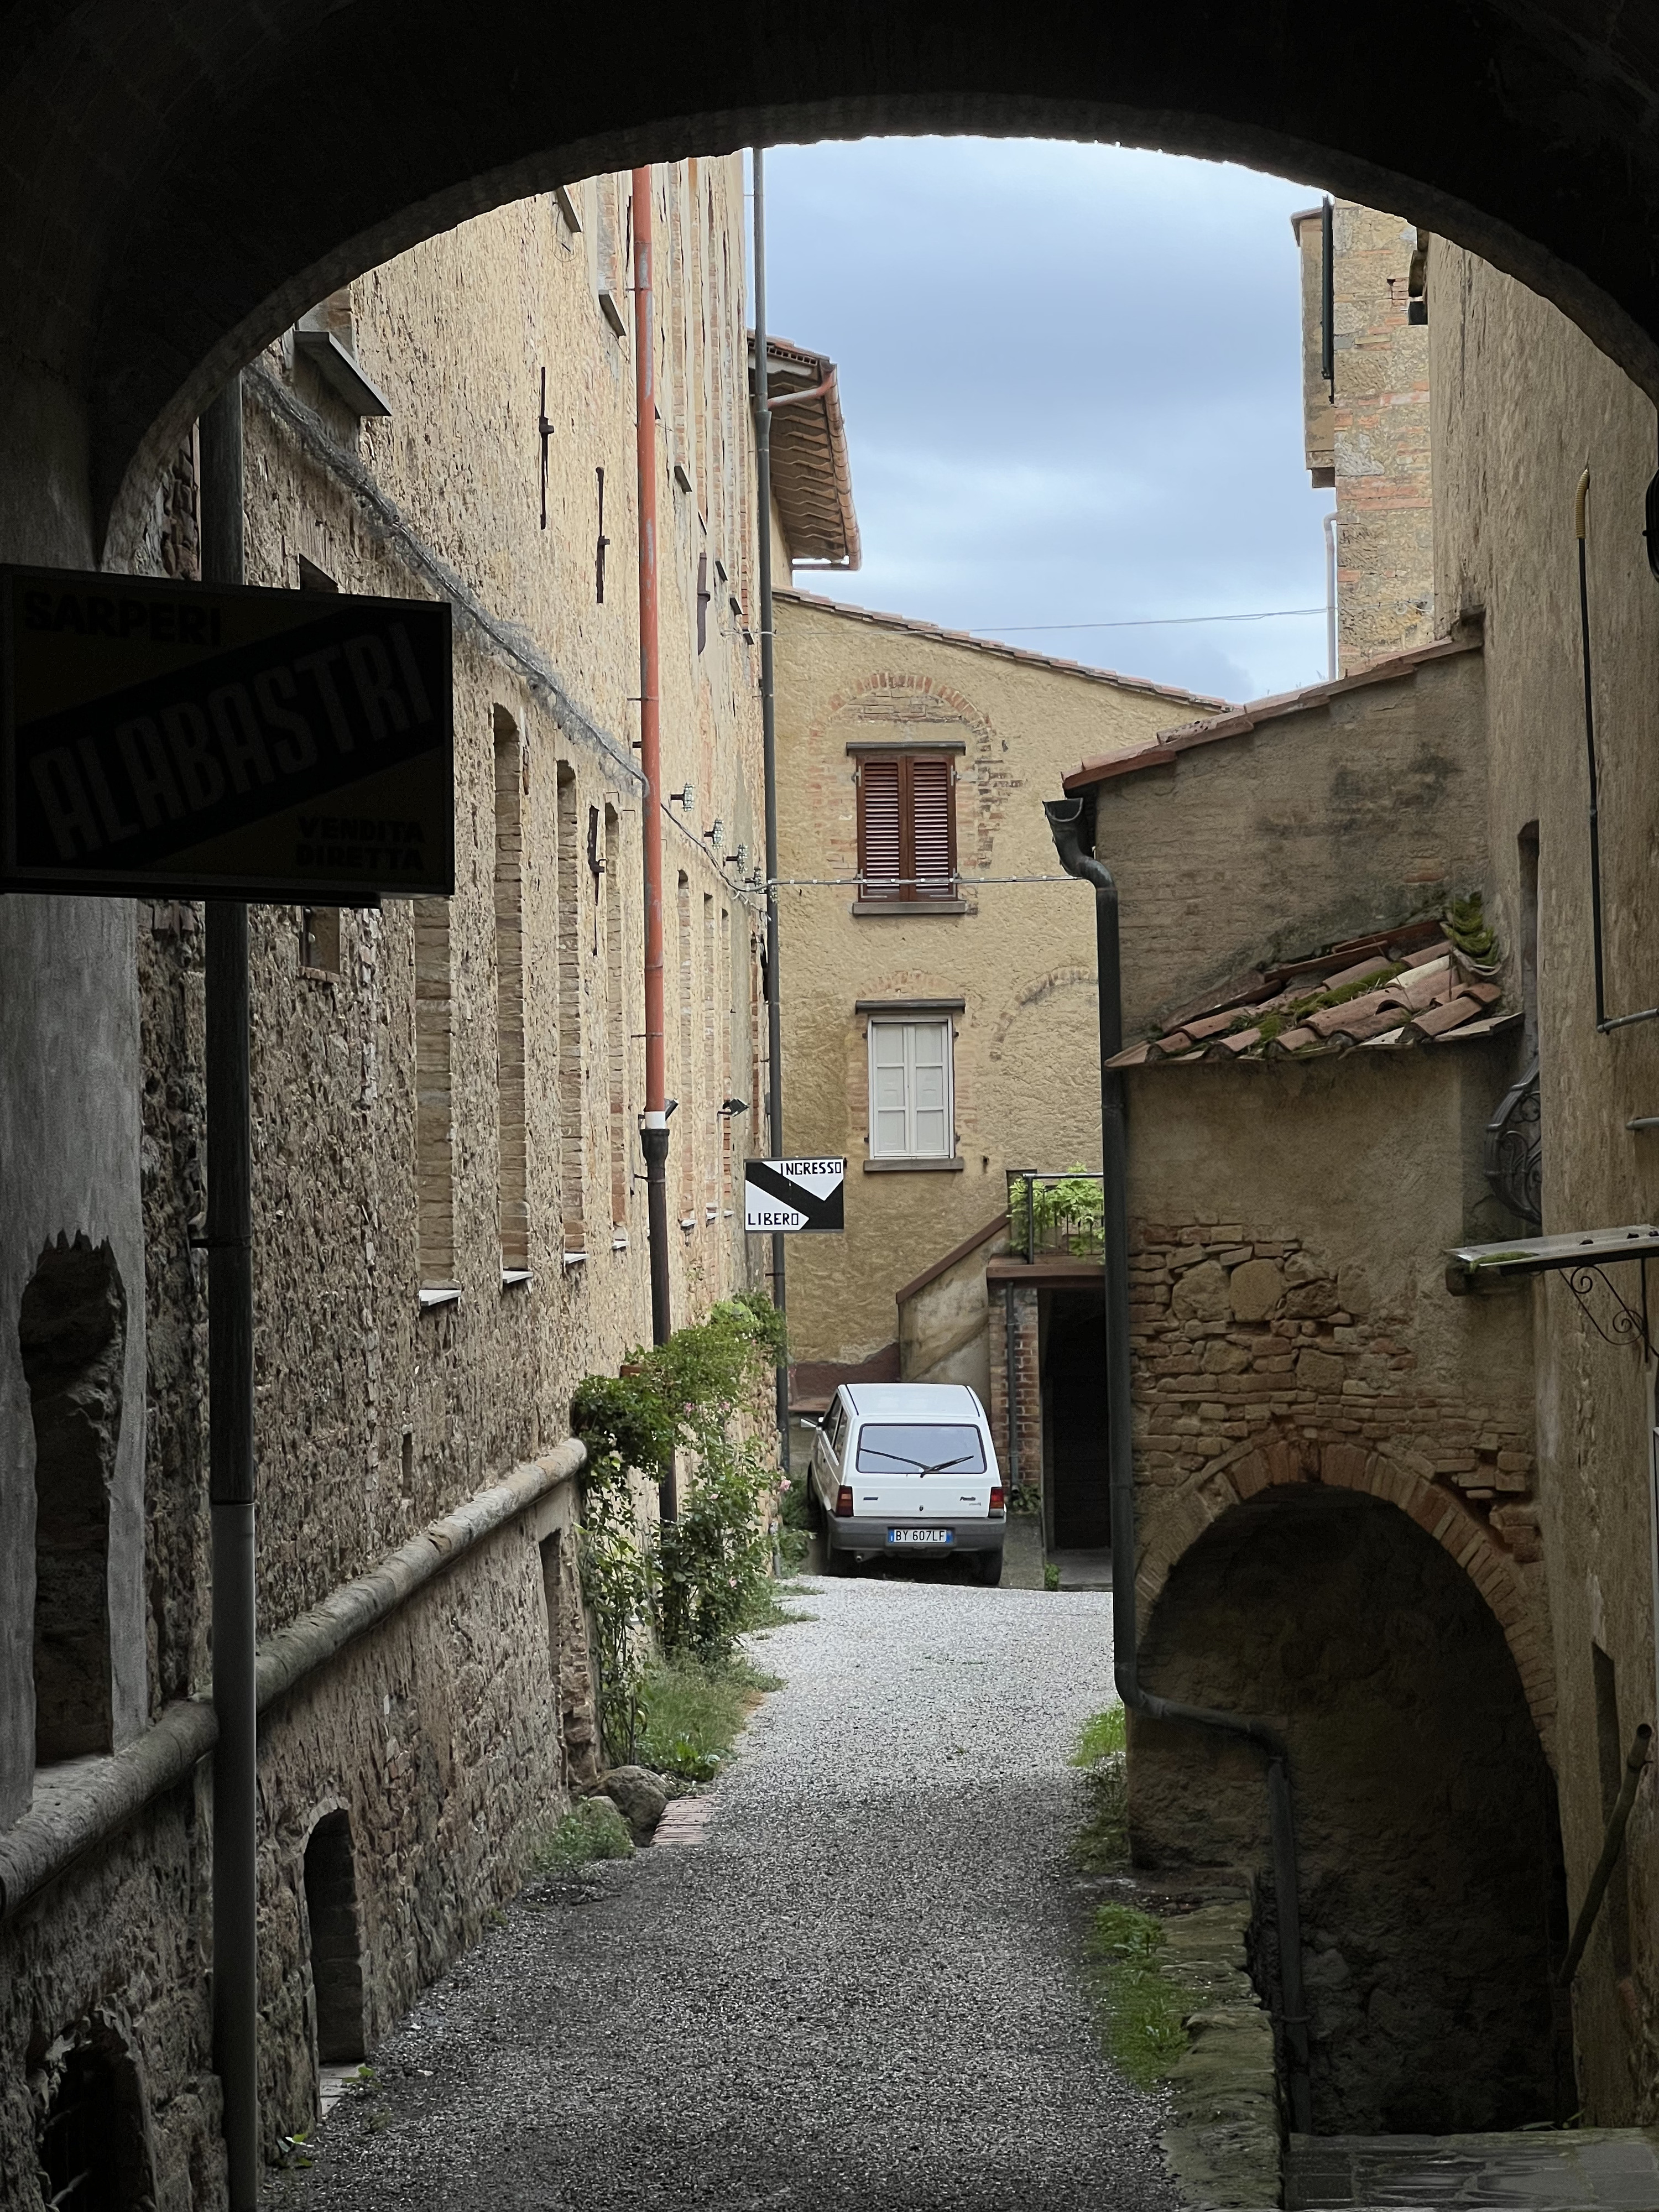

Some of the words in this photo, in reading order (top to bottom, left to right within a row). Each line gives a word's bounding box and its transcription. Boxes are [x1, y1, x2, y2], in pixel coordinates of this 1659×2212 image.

[24, 591, 221, 647] SARPERI
[28, 620, 435, 861] ALABASTRI
[300, 818, 426, 844] VENDITA
[296, 843, 424, 870] DIRETTA
[780, 1162, 841, 1176] INGRESSO
[748, 1213, 799, 1225] LIBERO
[896, 1530, 908, 1541] BY
[912, 1530, 945, 1541] 607LF
